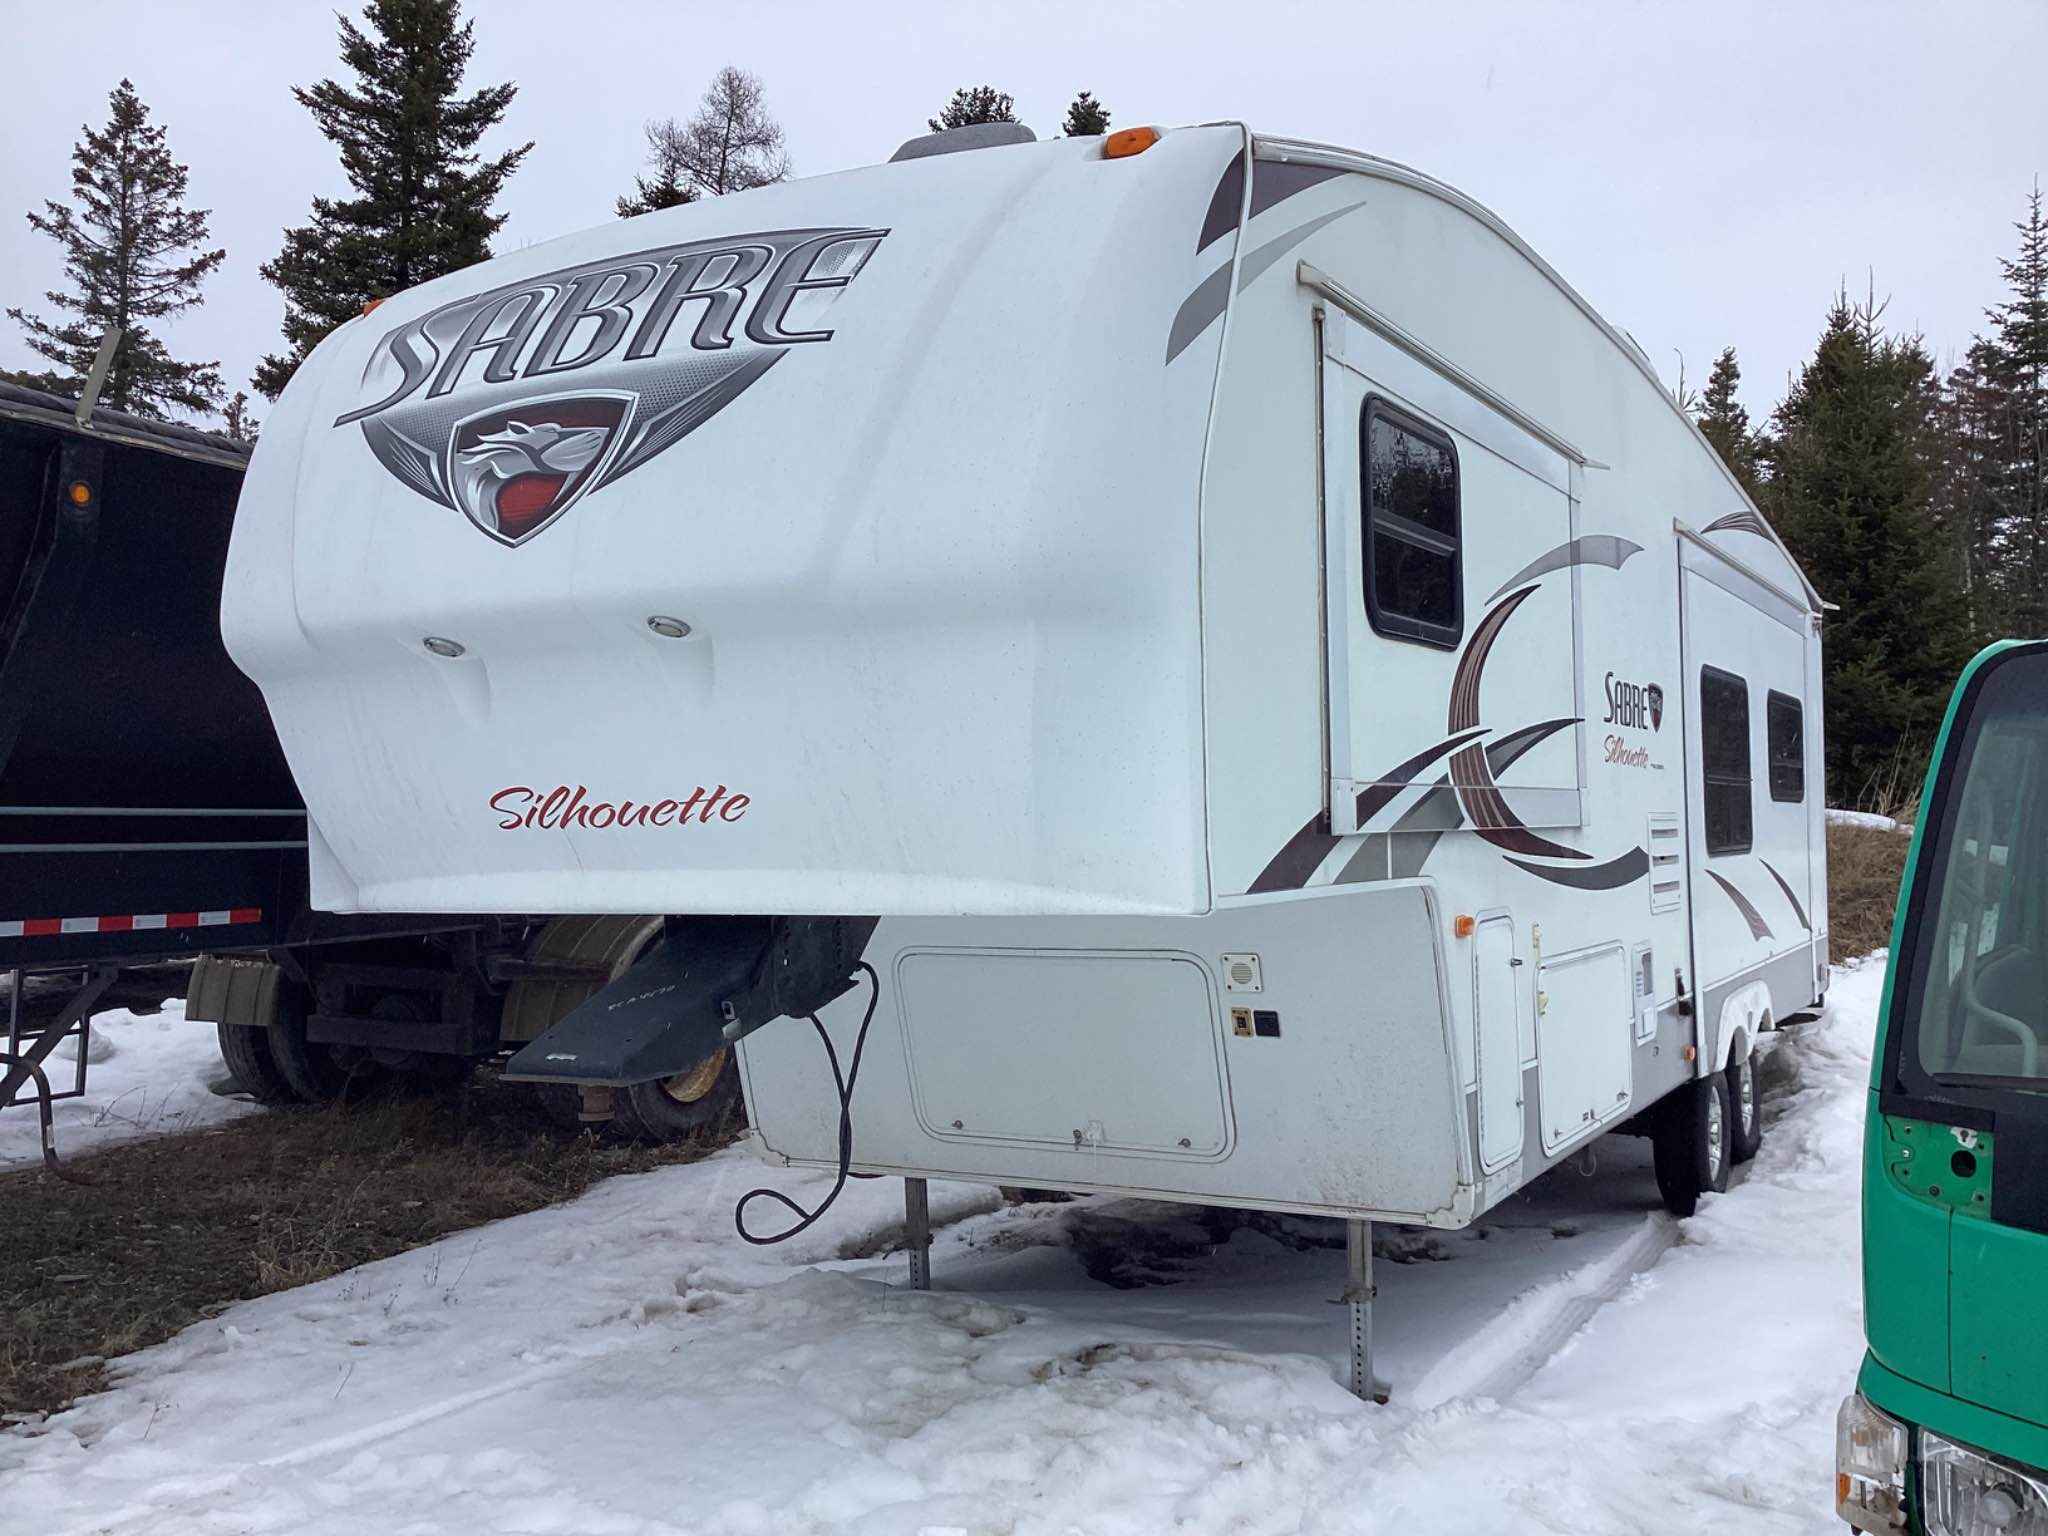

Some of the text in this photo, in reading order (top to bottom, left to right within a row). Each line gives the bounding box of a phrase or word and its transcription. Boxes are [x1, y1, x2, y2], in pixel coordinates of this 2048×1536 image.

[333, 229, 890, 427] SABRE
[1603, 671, 1649, 730] SABRE
[1603, 734, 1649, 769] Silhouette
[490, 784, 751, 831] Silhouette
